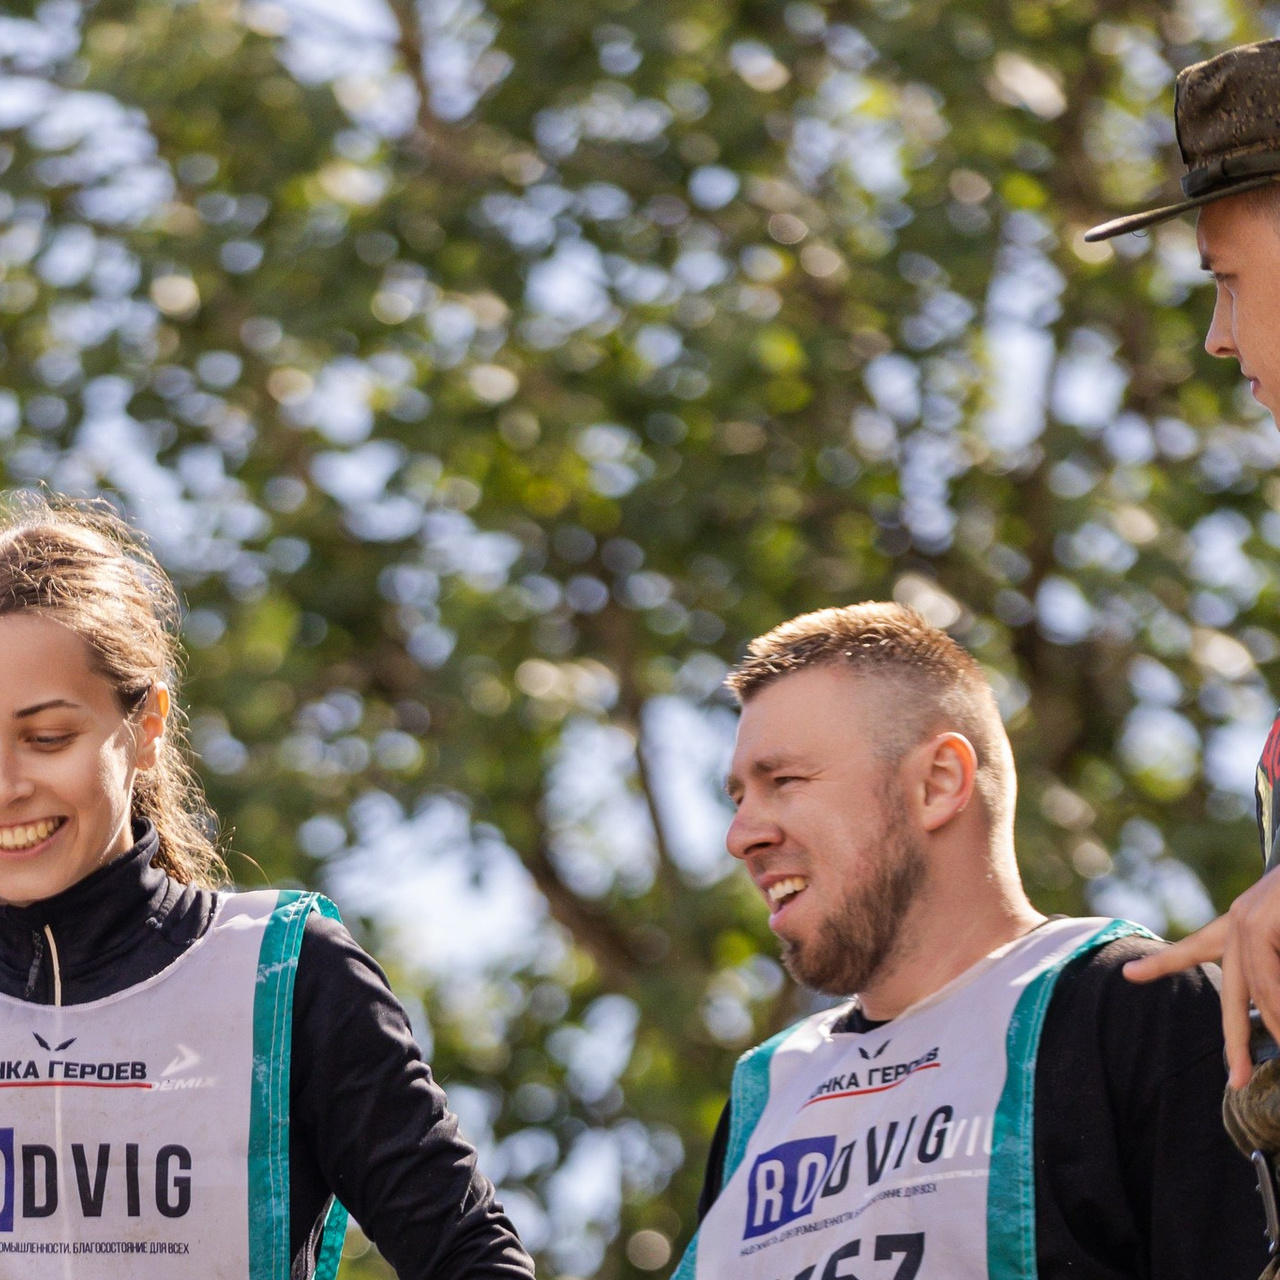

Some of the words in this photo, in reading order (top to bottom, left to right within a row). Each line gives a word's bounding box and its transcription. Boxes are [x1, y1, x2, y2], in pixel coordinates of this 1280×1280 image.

[47, 1060, 148, 1081] ГЕРОЕВ
[73, 1241, 148, 1254] БЛАГОСОСТОЯНИЕ
[150, 1242, 167, 1255] ДЛЯ
[167, 1242, 190, 1255] ВСЕХ
